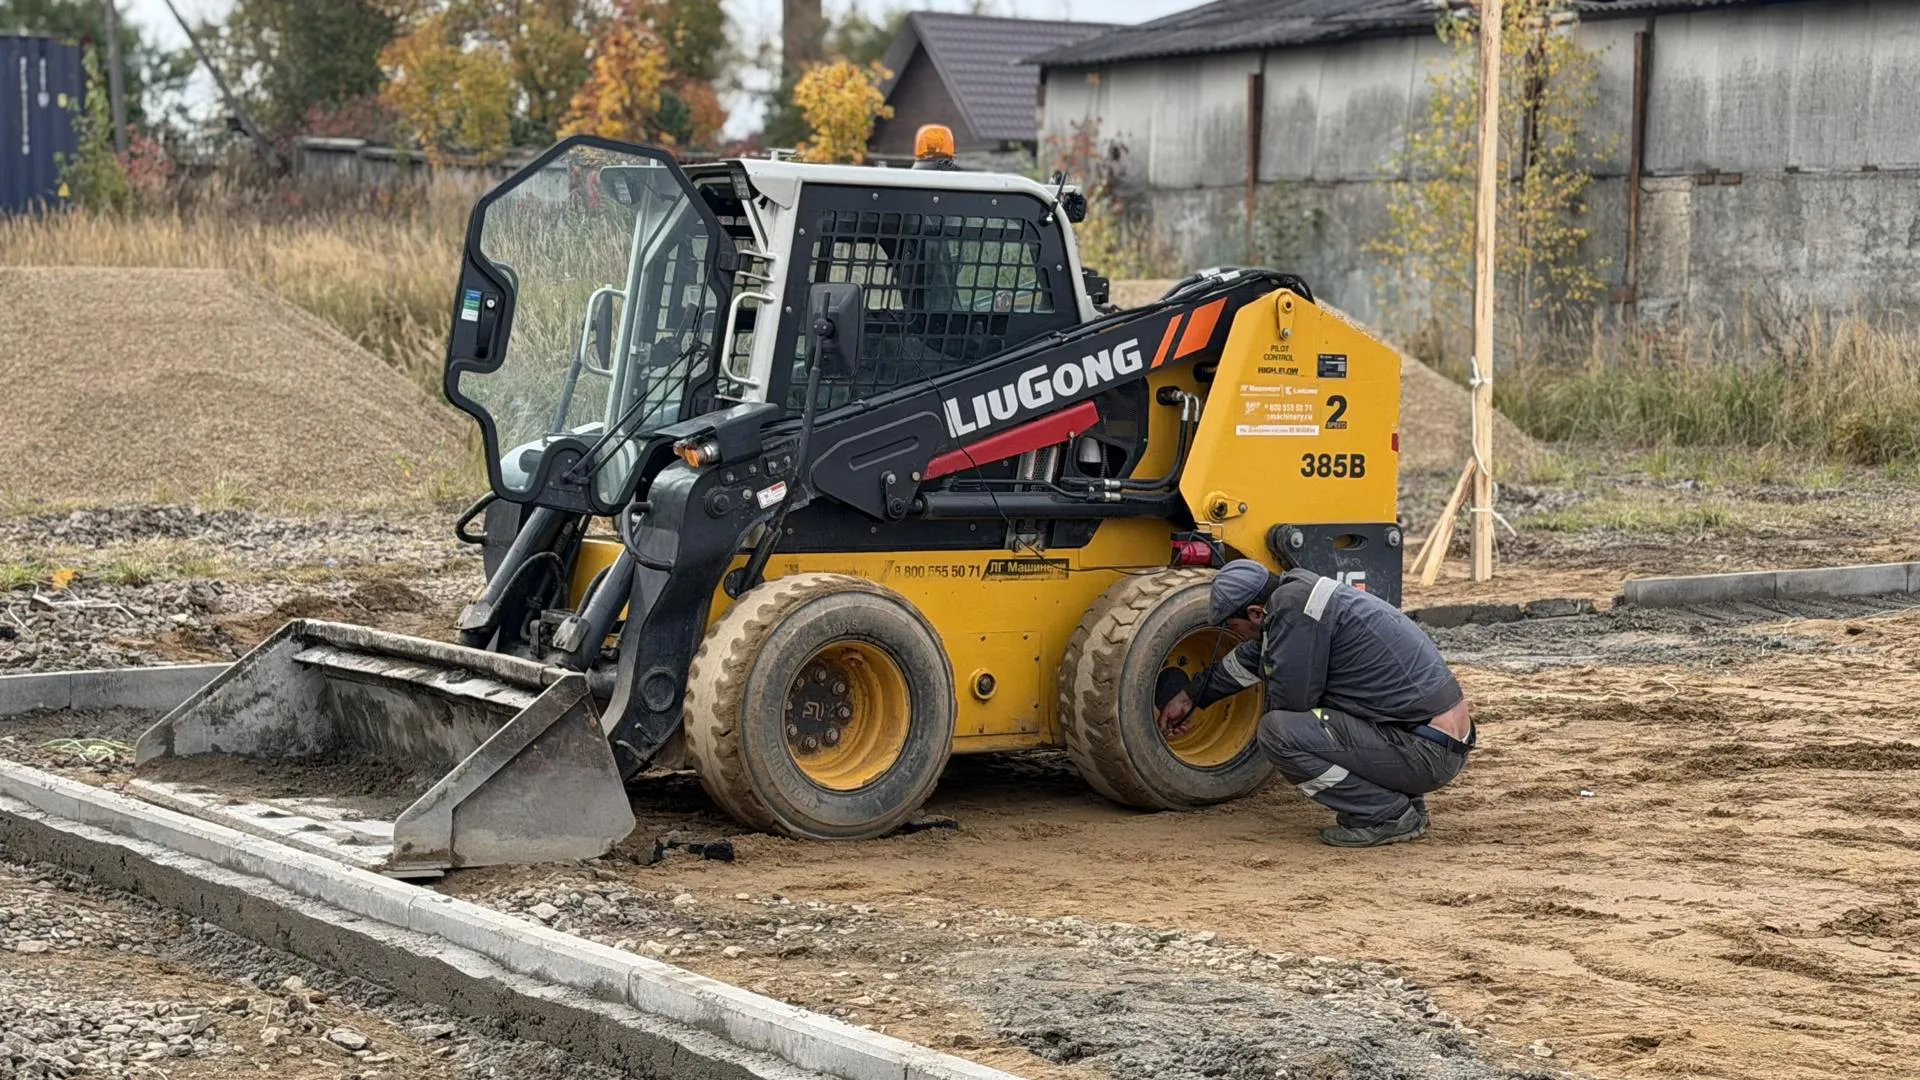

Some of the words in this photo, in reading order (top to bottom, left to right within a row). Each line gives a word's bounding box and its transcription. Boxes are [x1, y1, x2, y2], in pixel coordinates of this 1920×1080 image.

[1270, 345, 1290, 353] PILOT
[1263, 353, 1295, 361] CONTROL
[943, 338, 1143, 438] LIUGONG
[1304, 403, 1313, 412] 71
[1326, 395, 1347, 422] 2
[1300, 453, 1366, 478] 385B
[927, 565, 949, 578] 555
[951, 565, 966, 578] 50
[968, 565, 980, 578] 71
[989, 562, 1003, 574] ЛГ
